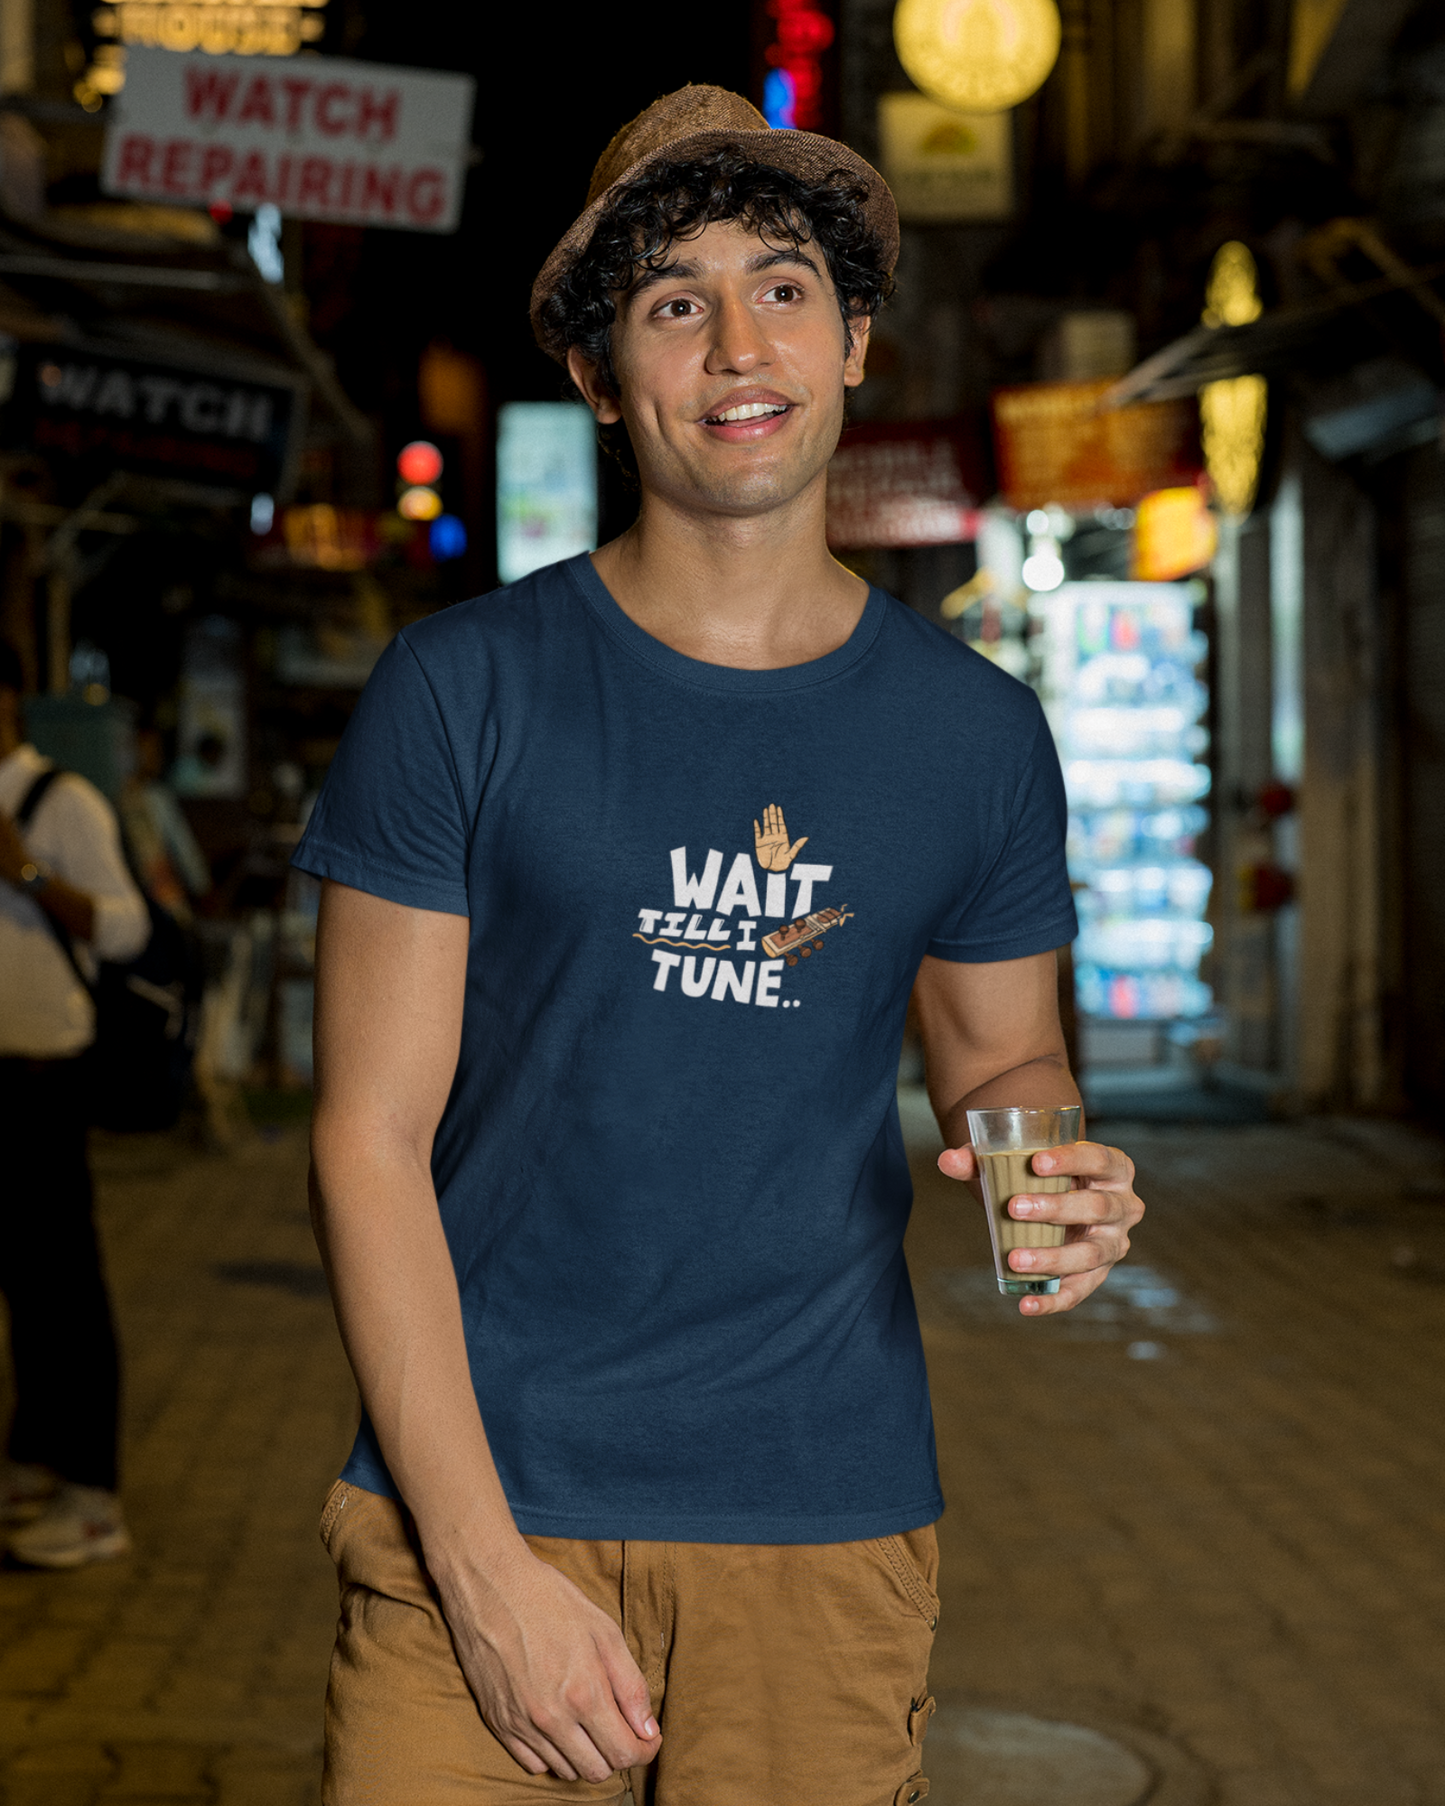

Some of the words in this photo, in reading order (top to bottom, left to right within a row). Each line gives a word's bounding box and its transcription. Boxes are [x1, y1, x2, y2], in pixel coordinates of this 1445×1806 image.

[184, 64, 401, 144] WATCH
[116, 132, 448, 225] REPAIRING
[37, 358, 274, 443] WATCH
[670, 846, 833, 919] WAIT
[638, 908, 731, 941] TILL
[736, 920, 757, 951] I
[651, 949, 800, 1008] TUNE..
